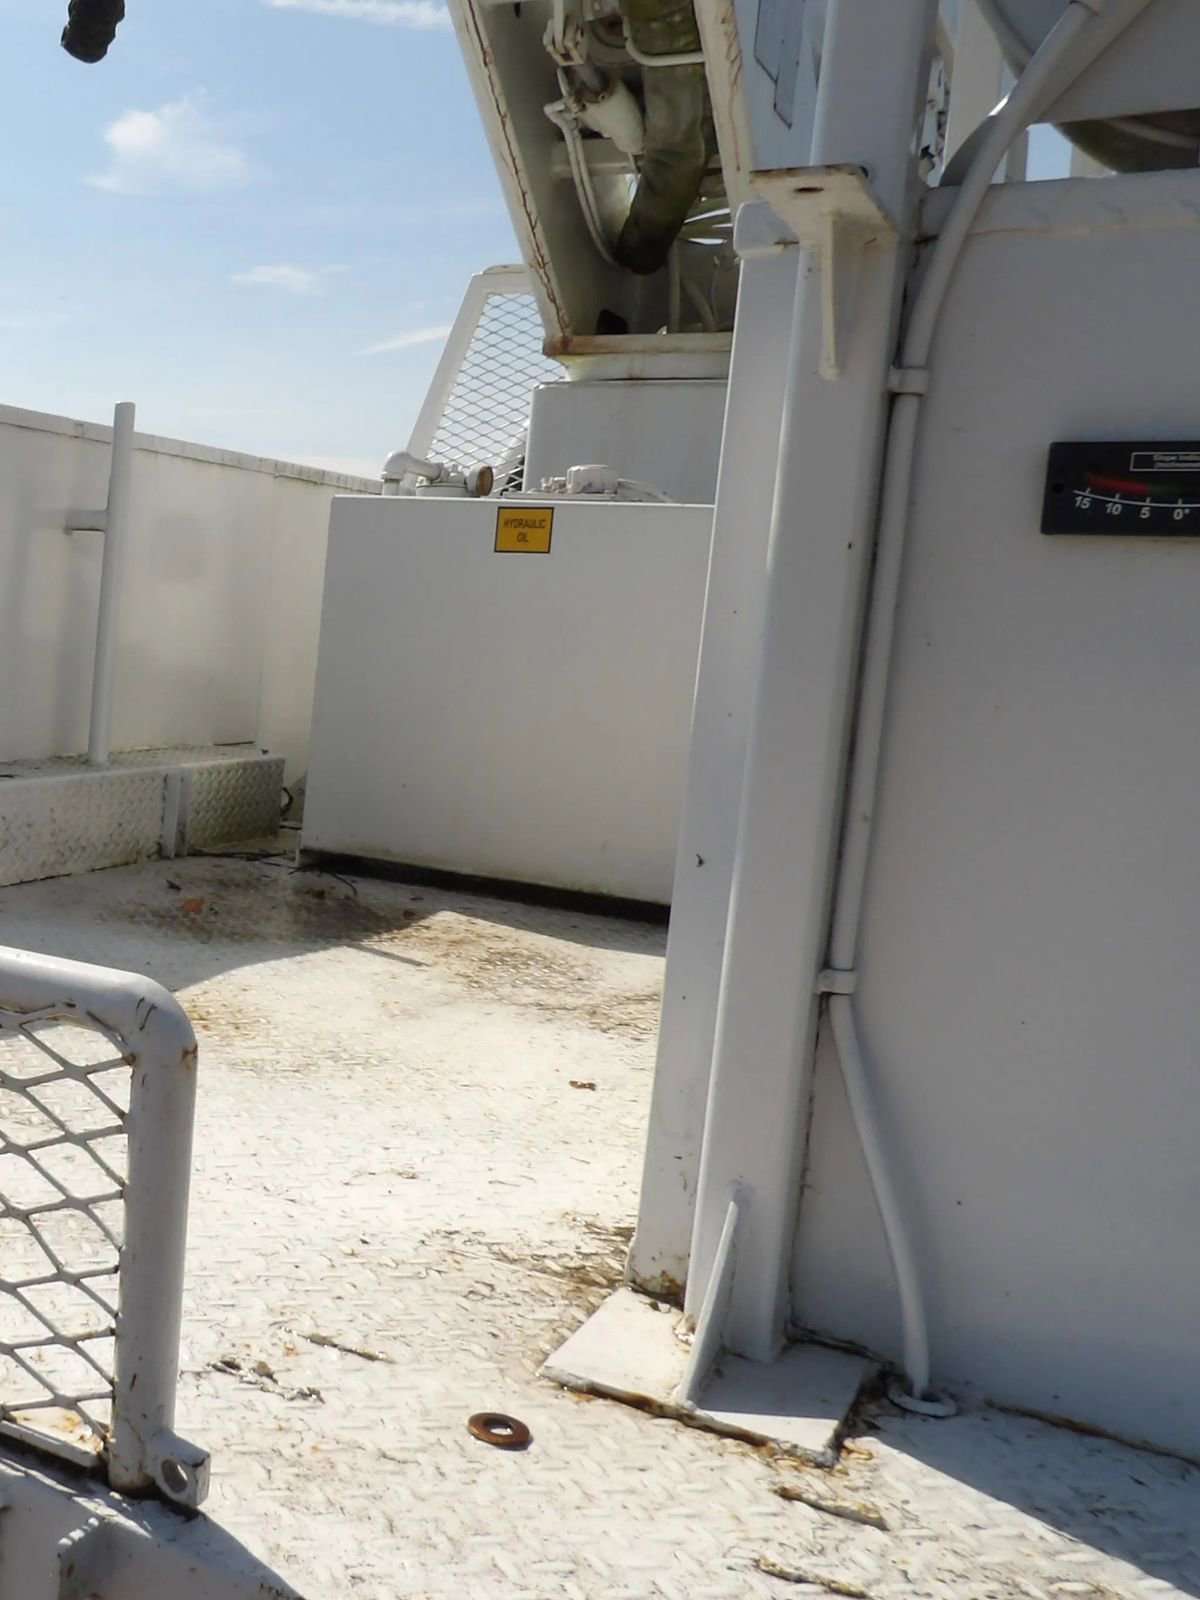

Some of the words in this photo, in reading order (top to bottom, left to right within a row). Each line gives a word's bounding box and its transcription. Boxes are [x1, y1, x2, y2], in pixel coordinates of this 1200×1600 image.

[1074, 496, 1091, 510] 15
[1105, 502, 1122, 515] 10
[1139, 507, 1151, 519] 5
[503, 518, 547, 529] HYDRAULIC
[516, 531, 529, 543] OIL
